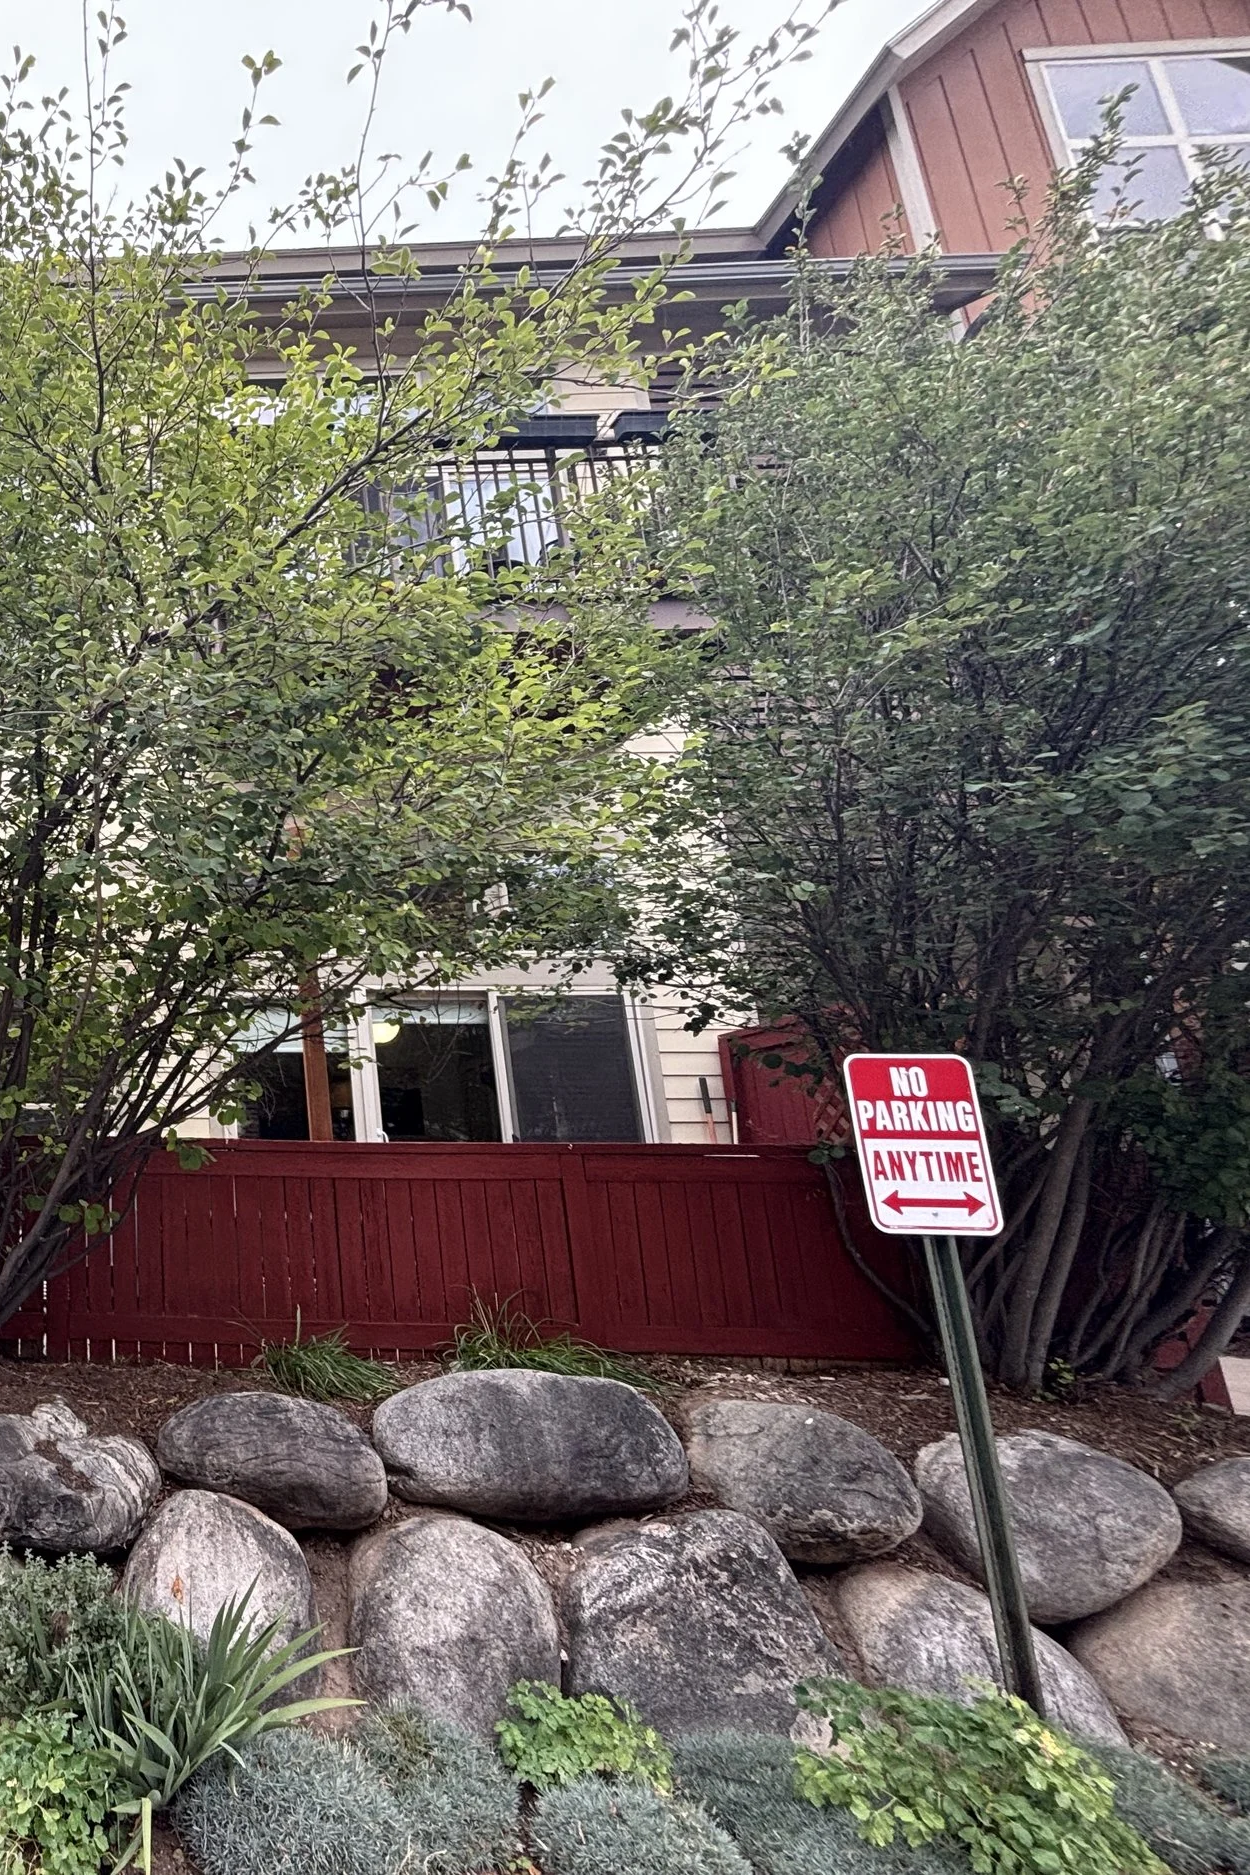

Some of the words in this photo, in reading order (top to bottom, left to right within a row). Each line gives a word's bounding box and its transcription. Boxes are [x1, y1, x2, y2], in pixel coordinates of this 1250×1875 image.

[888, 1066, 929, 1098] NO
[856, 1100, 977, 1132] PARKING
[873, 1150, 984, 1183] ANYTIME
